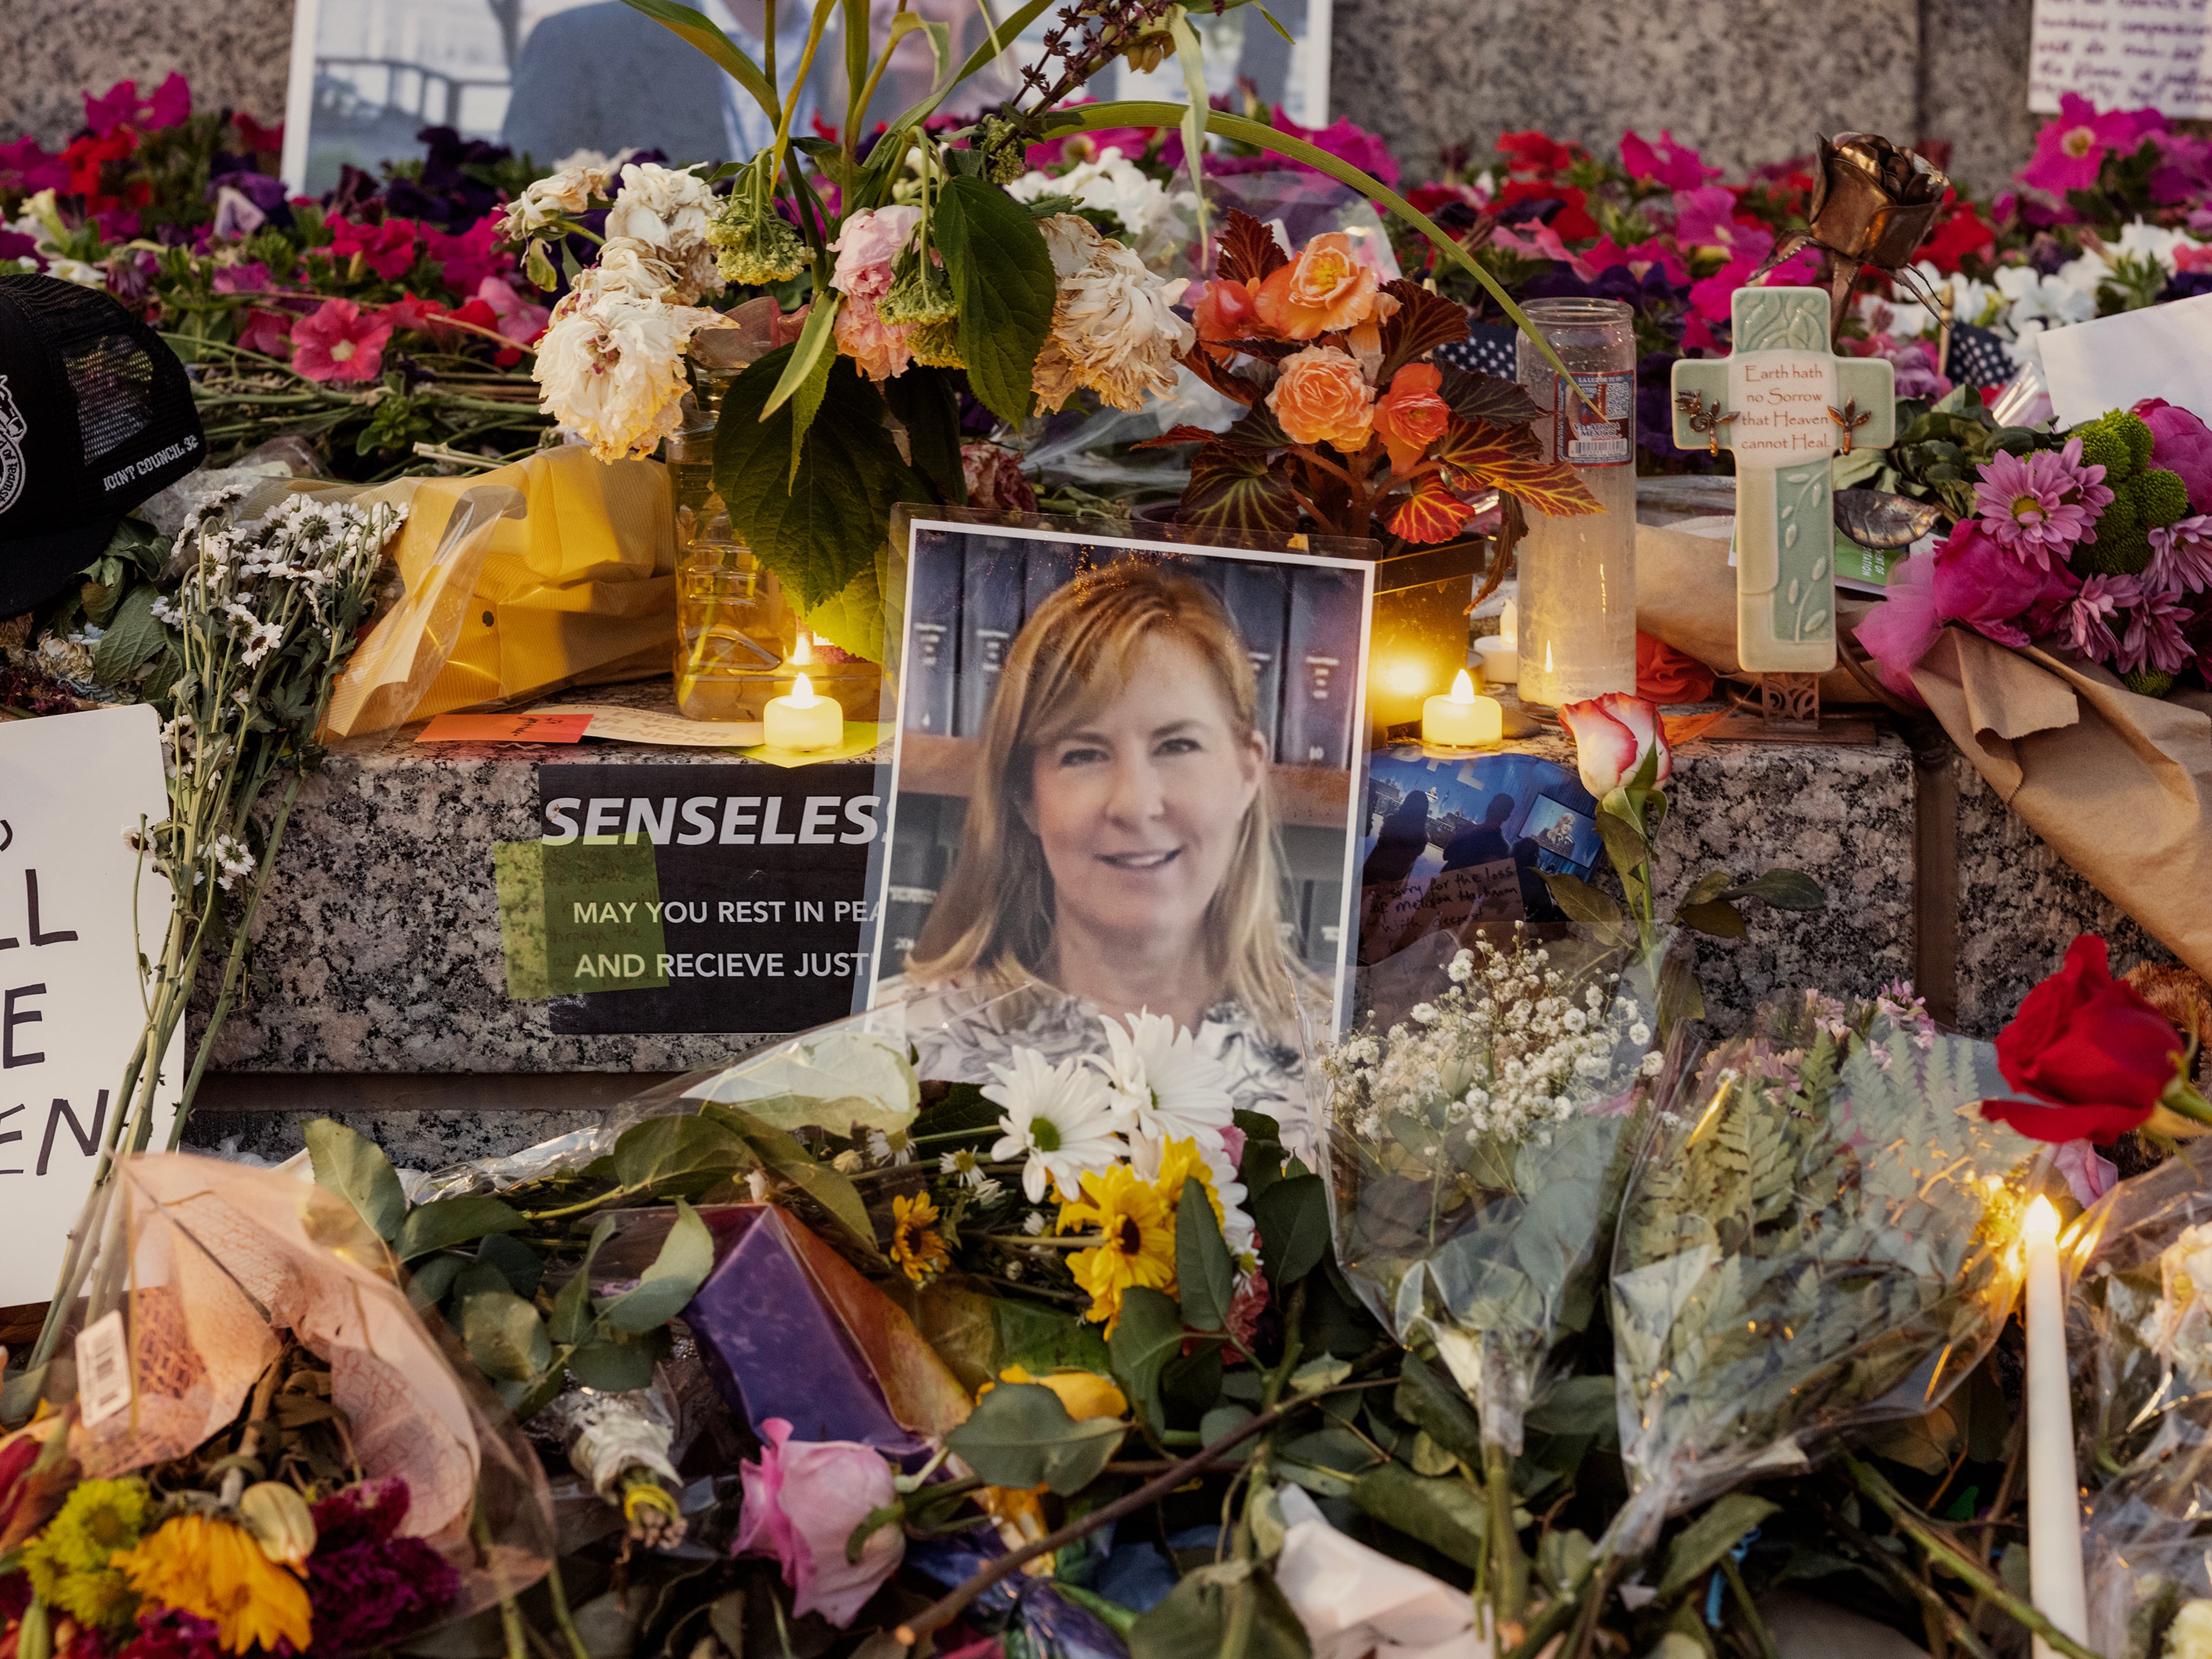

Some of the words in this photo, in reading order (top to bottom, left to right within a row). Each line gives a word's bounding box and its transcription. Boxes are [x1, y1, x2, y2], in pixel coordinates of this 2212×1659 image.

[1745, 364, 1788, 381] Earth
[1792, 363, 1823, 378] hath
[1747, 394, 1764, 402] no
[1767, 387, 1822, 404] Sorrow
[1742, 411, 1770, 426] that
[1774, 411, 1828, 427] Heaven
[1741, 438, 1788, 449] cannot
[1792, 433, 1830, 450] Heal.
[103, 465, 136, 491] JOINT
[136, 443, 186, 475] COUNCIL
[184, 434, 199, 452] 32
[613, 711, 700, 728] FREE
[641, 722, 730, 738] YOUR
[541, 795, 887, 846] SENSELES
[1391, 884, 1422, 900] sorry
[1430, 877, 1450, 895] for
[1455, 873, 1482, 886] the
[1485, 866, 1514, 883] loss
[573, 902, 638, 923] MAY
[644, 901, 708, 923] YOU
[718, 900, 786, 923] REST
[795, 900, 824, 923] IN
[1373, 901, 1388, 920] of
[575, 953, 646, 978] AND
[657, 953, 784, 978] RECIEVE
